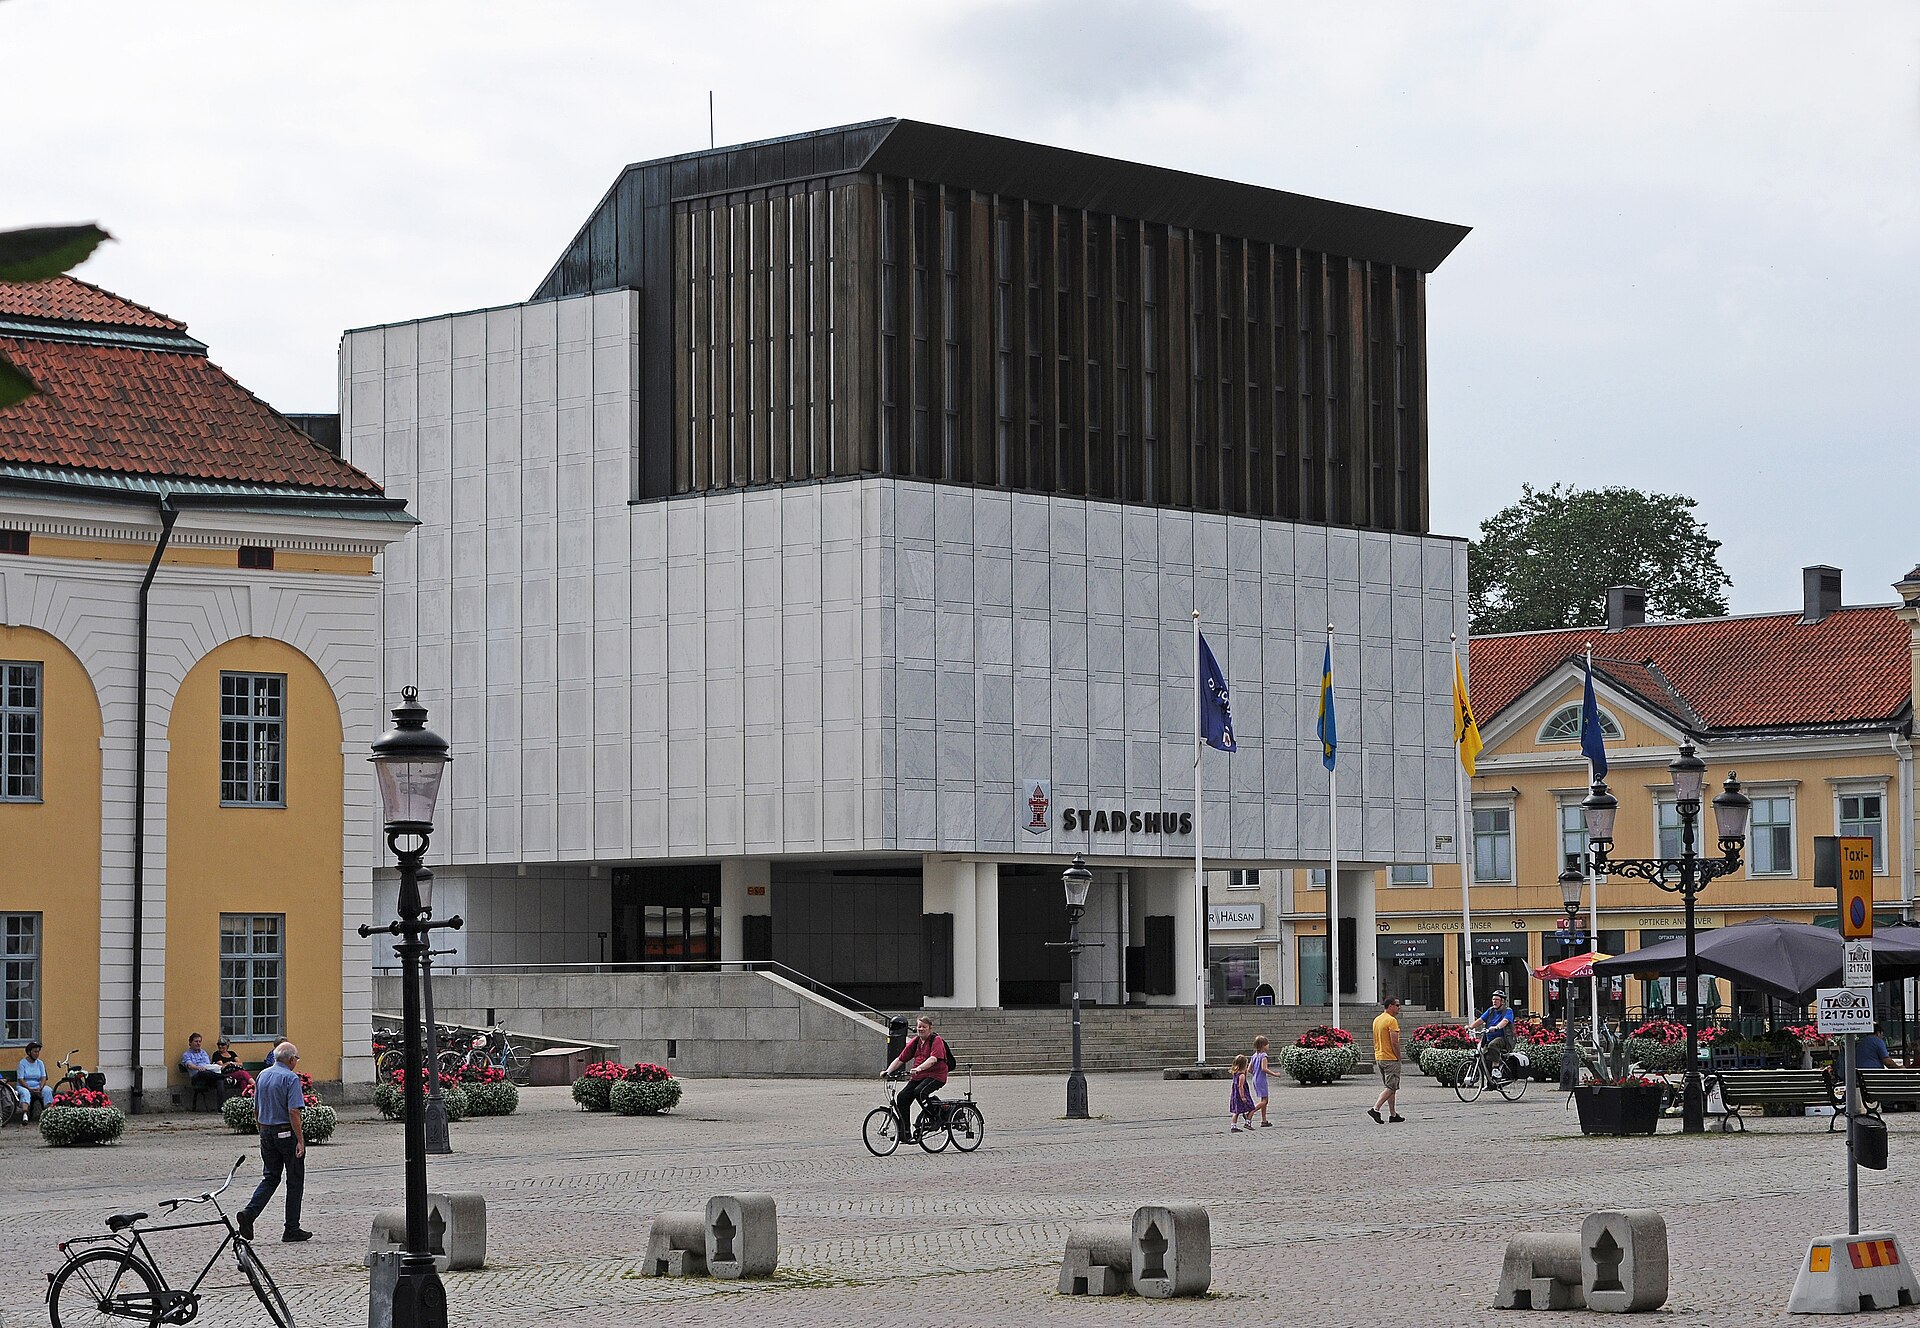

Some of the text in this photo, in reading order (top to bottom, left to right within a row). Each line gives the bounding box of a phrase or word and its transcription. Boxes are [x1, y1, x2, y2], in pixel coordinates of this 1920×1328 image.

[1063, 808, 1192, 834] STADSHUS
[1844, 847, 1868, 861] Taxi-
[1849, 870, 1864, 880] zon
[1220, 911, 1254, 922] HÄLSAN
[1824, 998, 1866, 1008] TAXI
